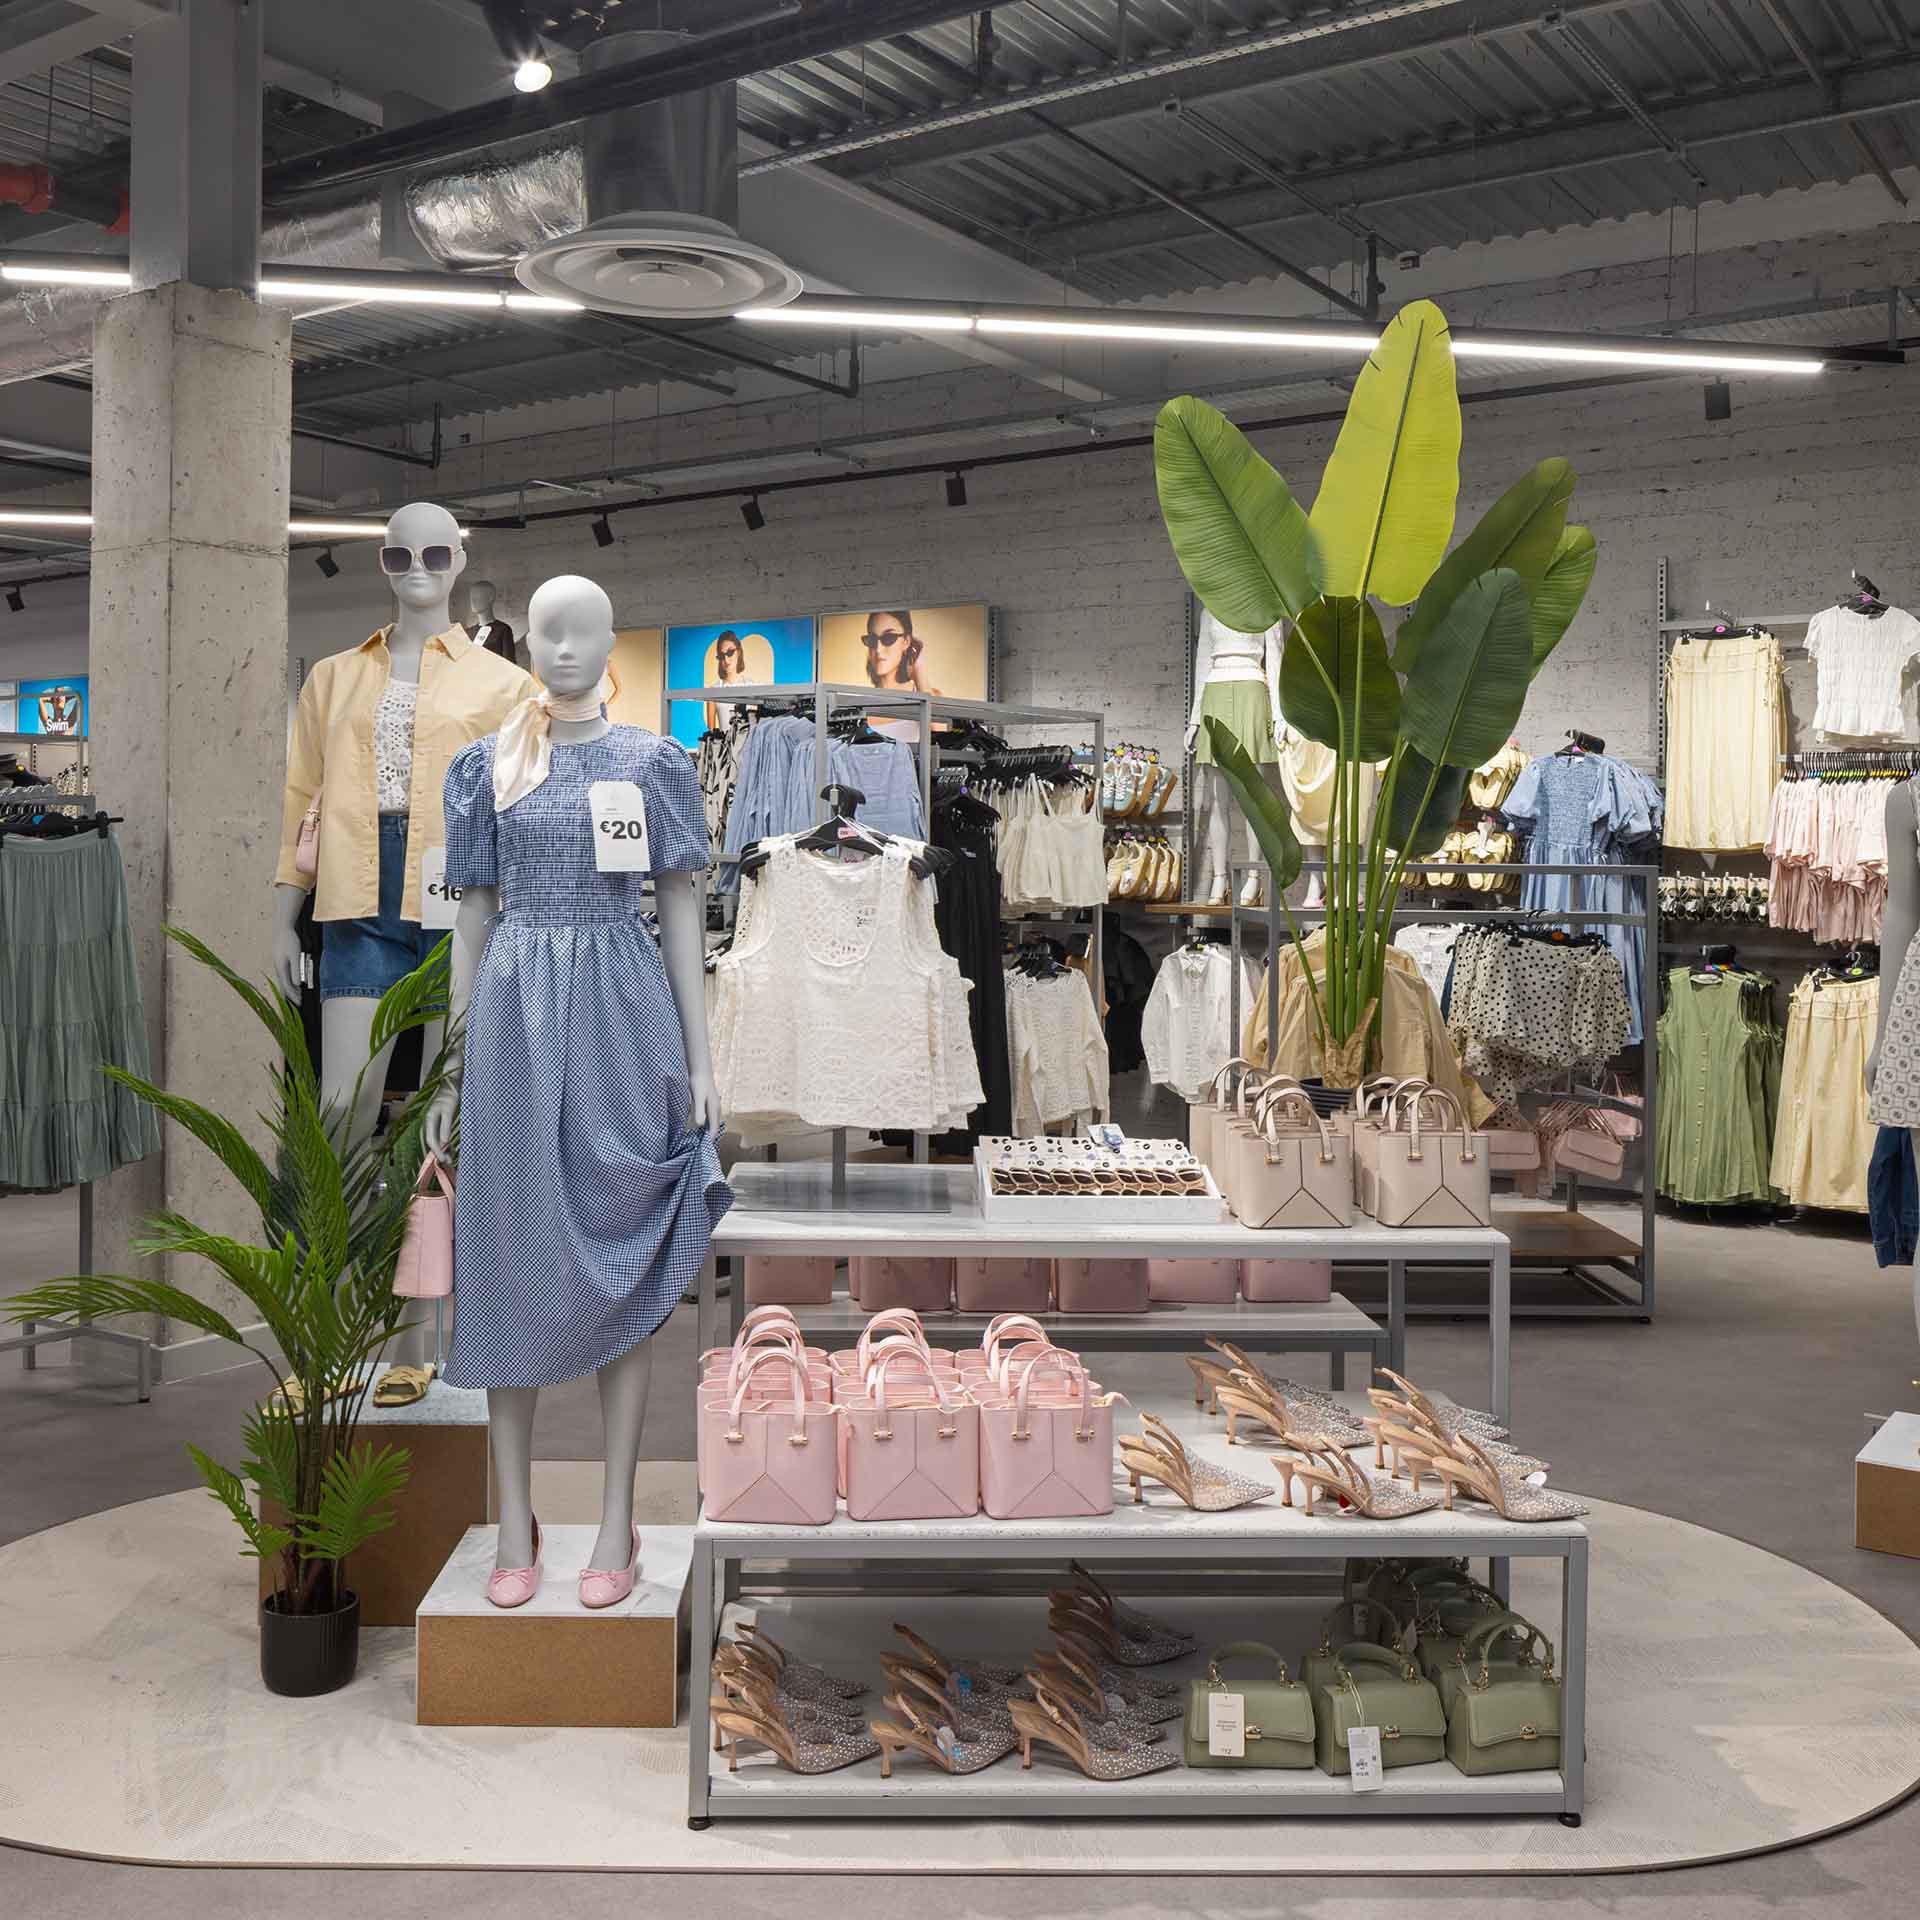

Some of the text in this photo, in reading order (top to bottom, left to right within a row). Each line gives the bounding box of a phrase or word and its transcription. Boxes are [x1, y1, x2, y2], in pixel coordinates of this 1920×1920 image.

[46, 719, 68, 731] Swim
[600, 820, 642, 839] €20
[428, 883, 462, 901] €16
